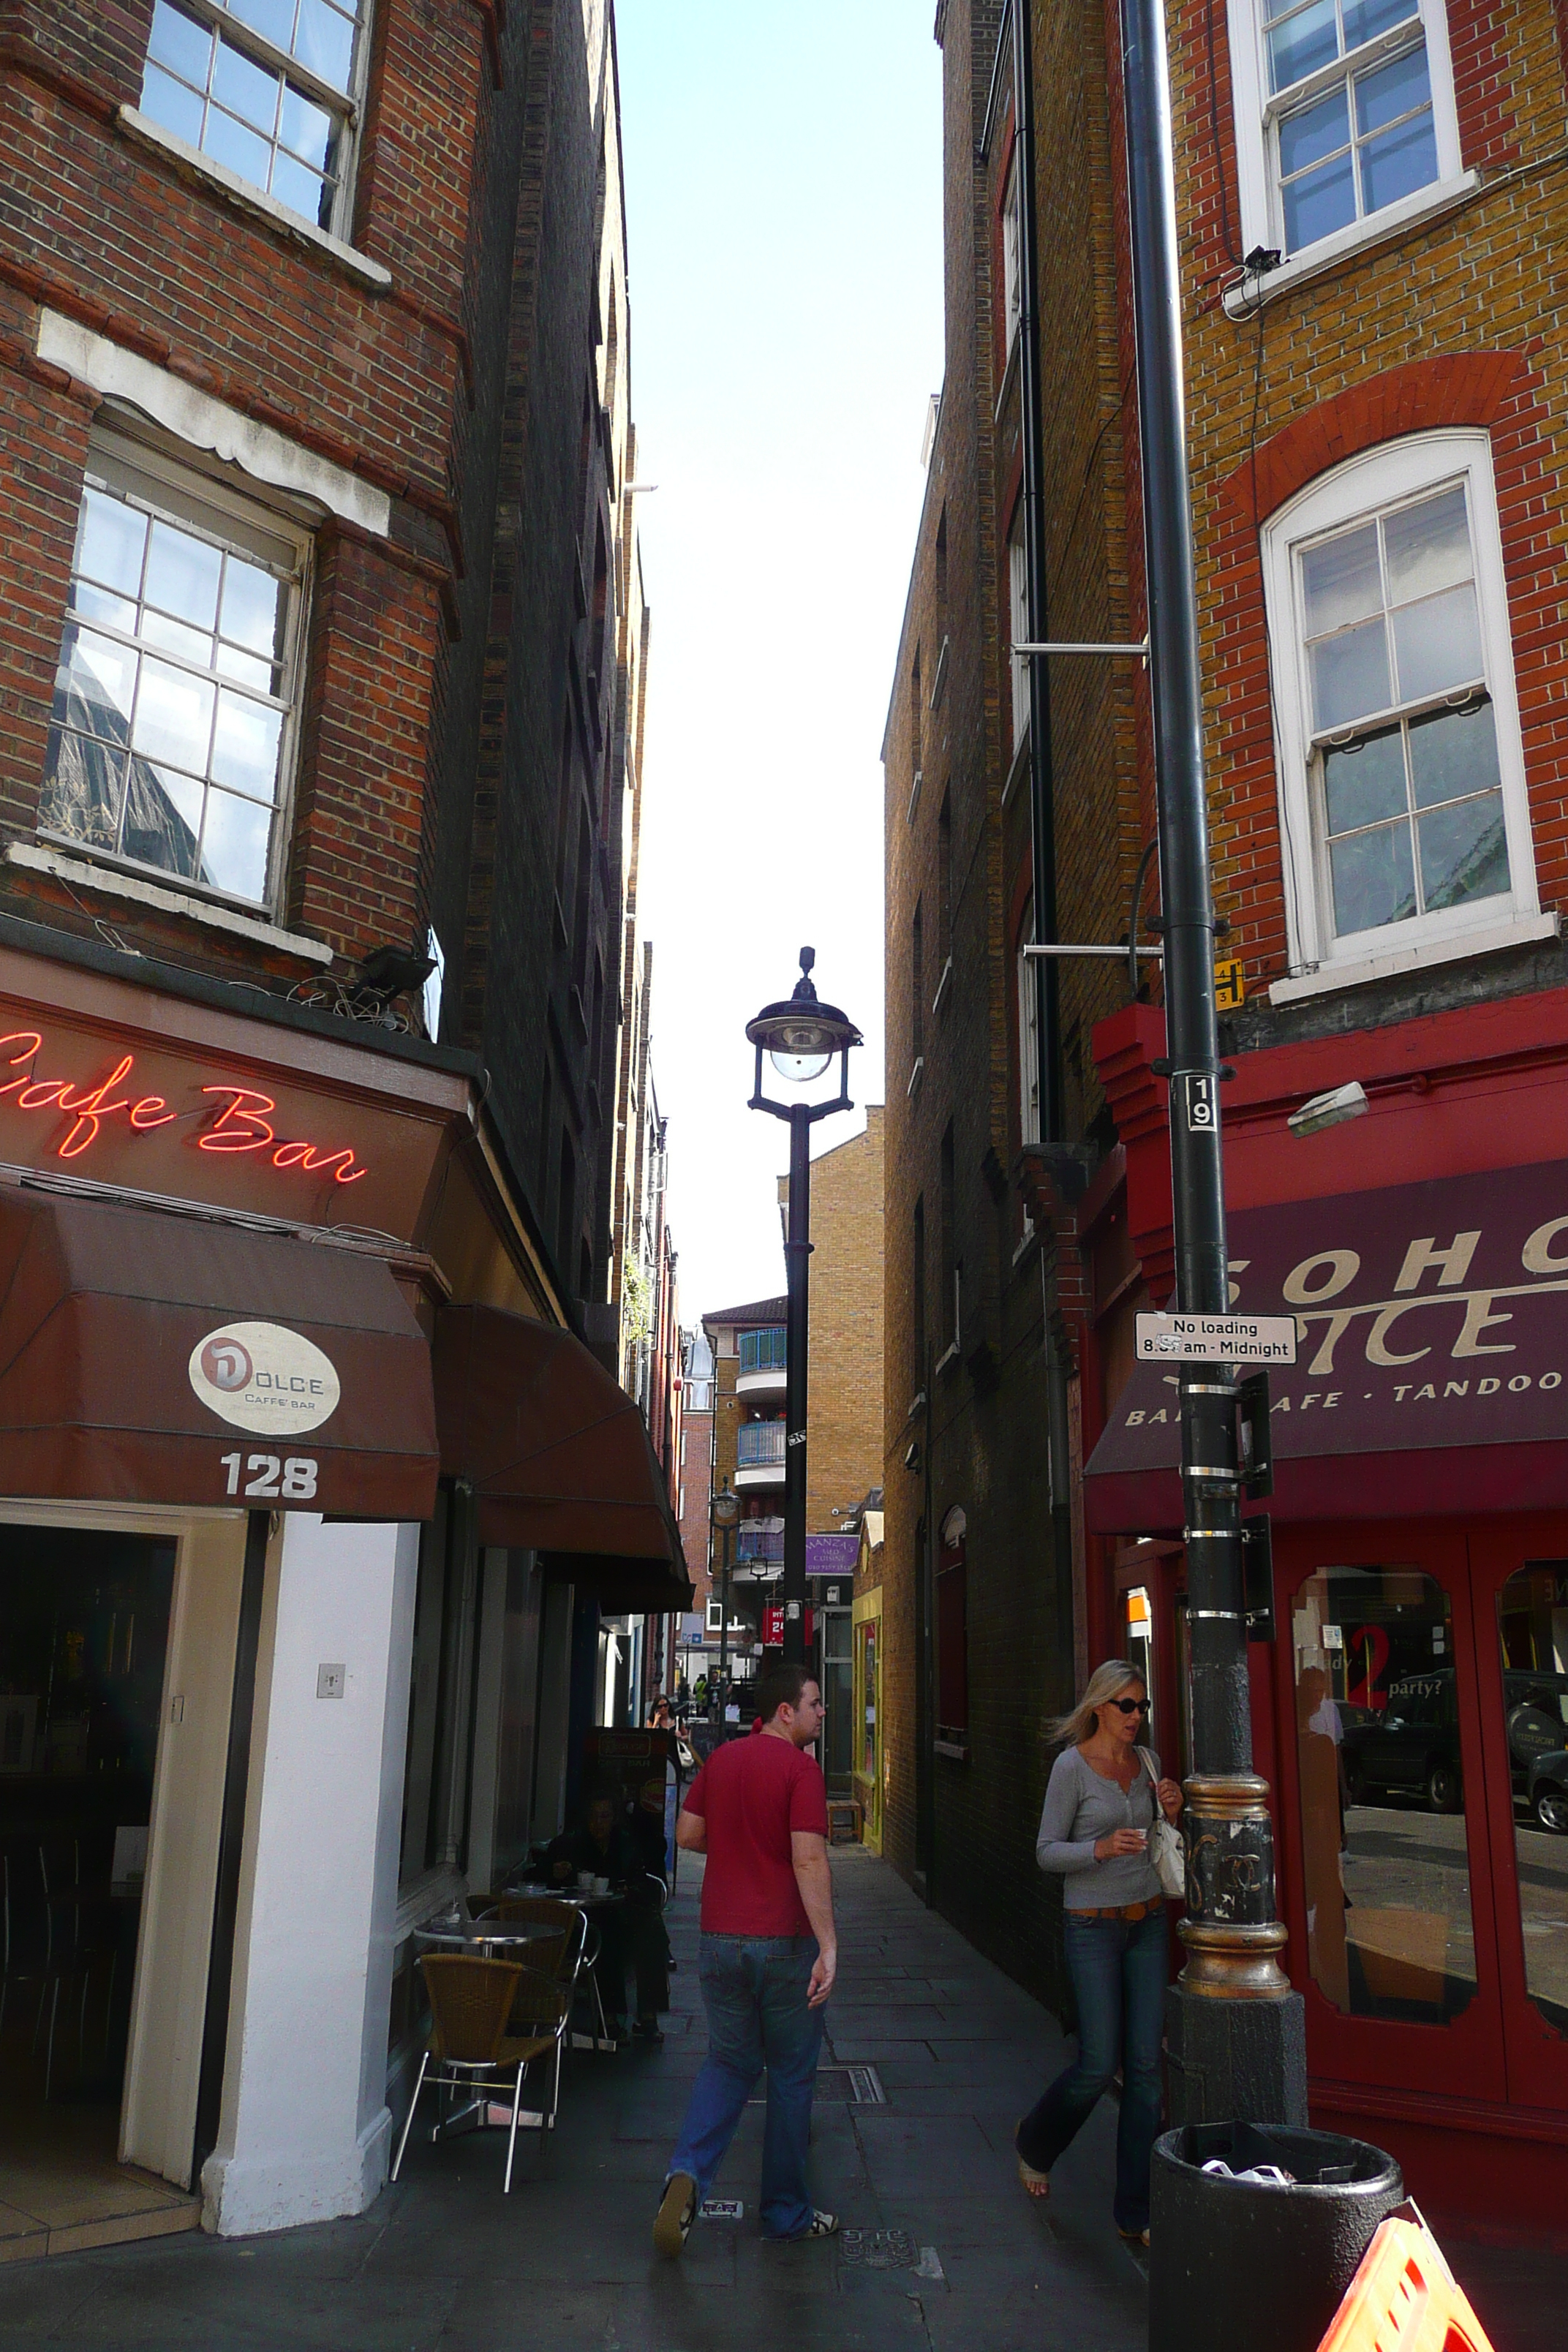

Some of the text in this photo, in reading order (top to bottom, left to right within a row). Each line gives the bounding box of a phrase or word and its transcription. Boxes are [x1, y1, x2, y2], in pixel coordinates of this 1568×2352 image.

[1219, 992, 1226, 1002] 3
[0, 1032, 368, 1183] Cafe Bar
[1174, 1320, 1257, 1337] No loading
[1221, 1341, 1289, 1357] Midnight
[1270, 1392, 1343, 1413] AFE
[1394, 1372, 1562, 1402] TANDOO
[291, 1401, 316, 1410] BAR
[221, 1452, 318, 1499] 128
[1348, 1625, 1389, 1709] 2
[1389, 1680, 1442, 1699] party?
